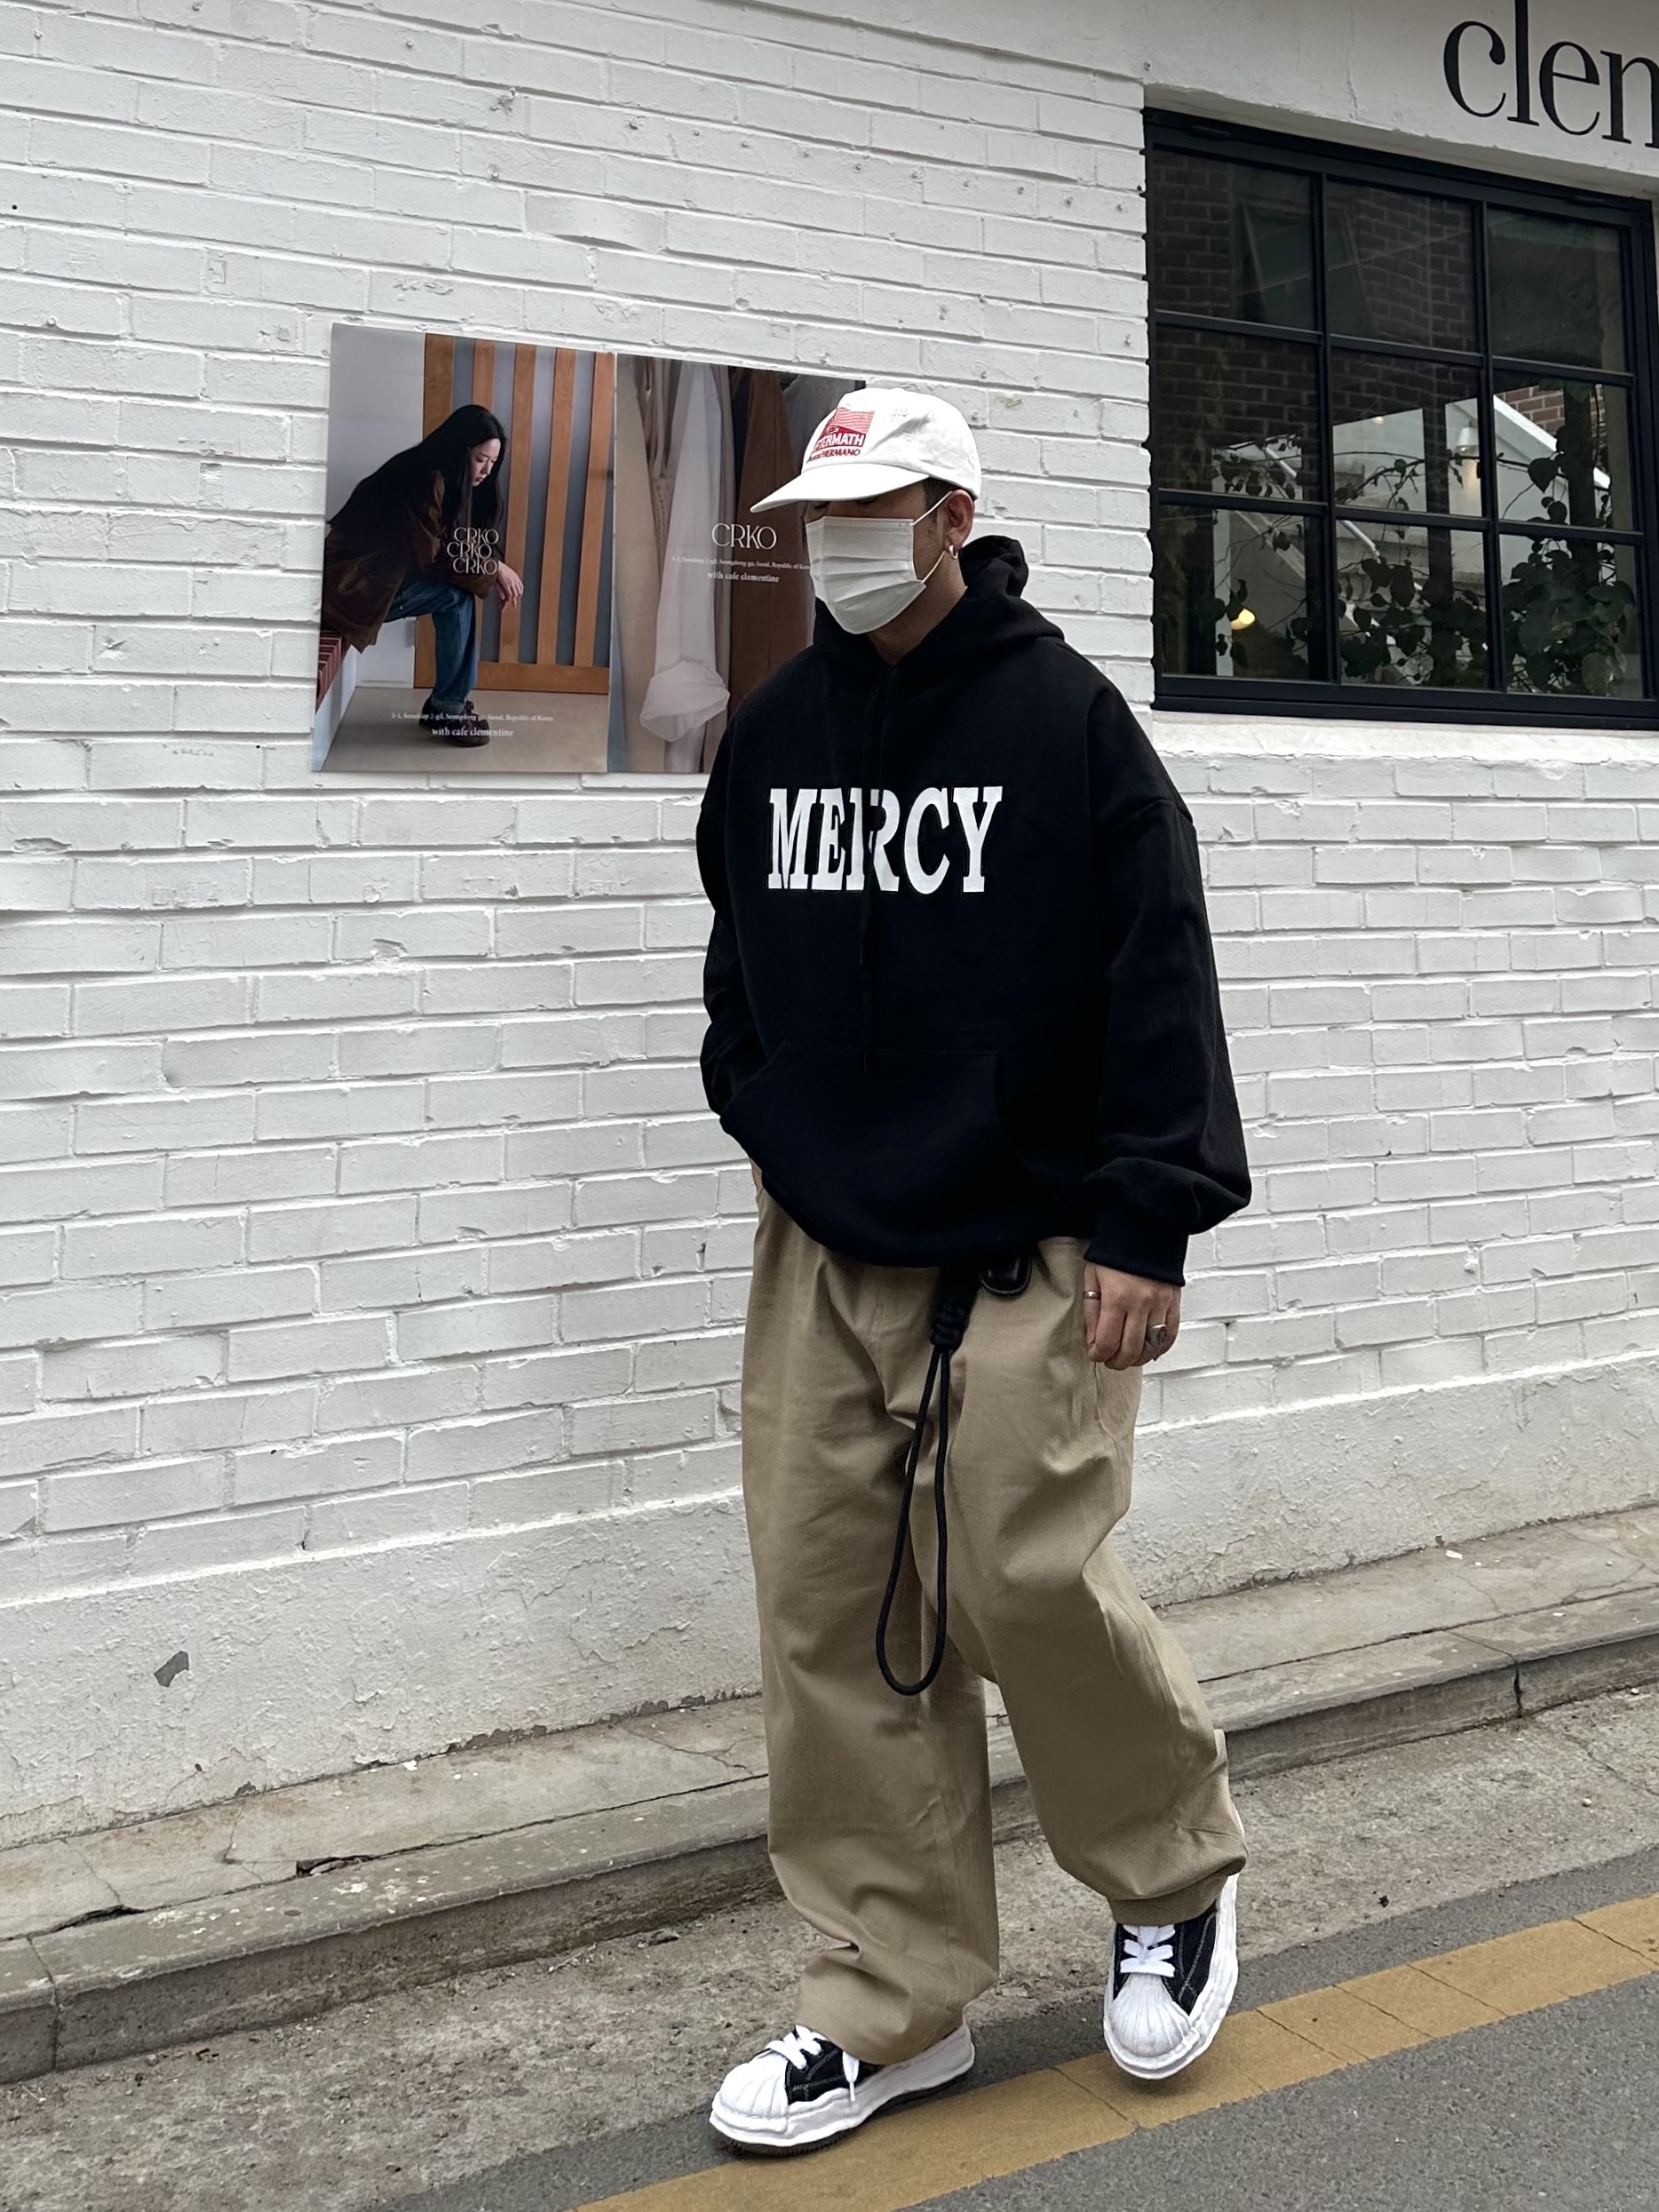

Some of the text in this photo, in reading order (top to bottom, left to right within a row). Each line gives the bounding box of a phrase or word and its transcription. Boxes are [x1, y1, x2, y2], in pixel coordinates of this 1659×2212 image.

[454, 527, 499, 545] CRKO
[711, 522, 777, 550] CRKO
[447, 541, 492, 560] CRKO
[453, 557, 497, 575] CRKO
[708, 571, 780, 583] with cafe clementine
[432, 727, 514, 736] with cafe clementine
[768, 786, 1003, 895] MERCY
